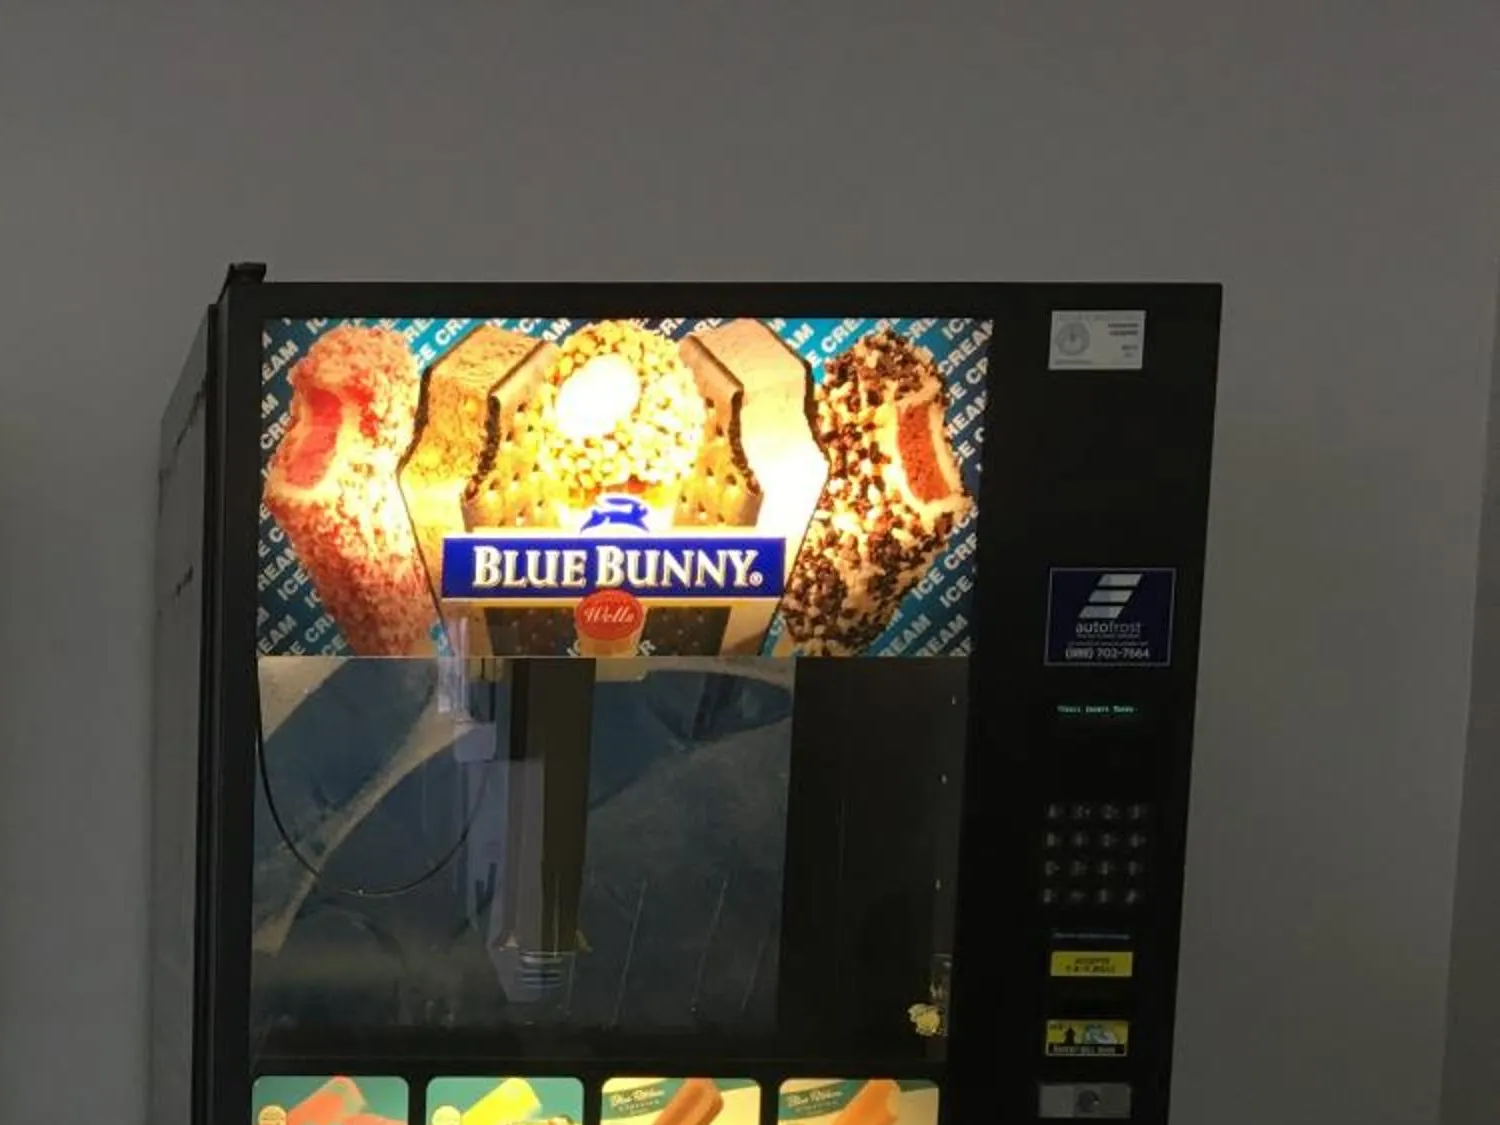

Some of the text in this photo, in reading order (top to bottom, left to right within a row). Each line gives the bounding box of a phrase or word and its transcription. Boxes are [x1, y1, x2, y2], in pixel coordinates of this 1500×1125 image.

[473, 545, 587, 588] BLUE
[276, 568, 309, 601] ICE
[911, 567, 945, 600] ICE
[940, 575, 974, 608] ICE
[583, 605, 636, 625] Wells
[1075, 619, 1142, 634] autofrost
